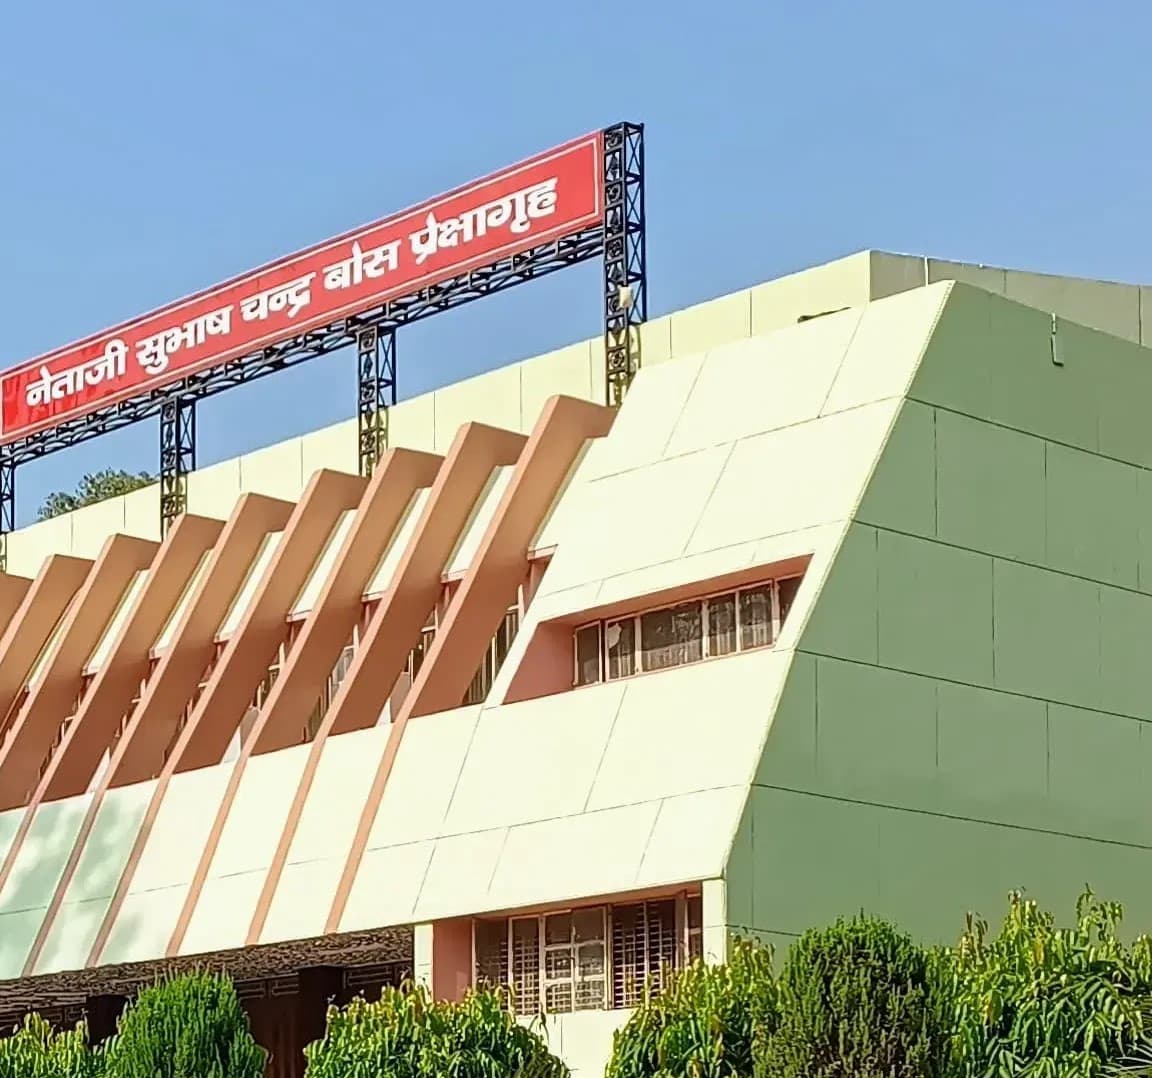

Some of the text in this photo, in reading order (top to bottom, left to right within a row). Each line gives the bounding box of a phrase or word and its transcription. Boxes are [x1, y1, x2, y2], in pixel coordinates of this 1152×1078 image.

[26, 176, 559, 406] नेताजी सुभाष चन्द्र बोस प्रेक्षागृह
